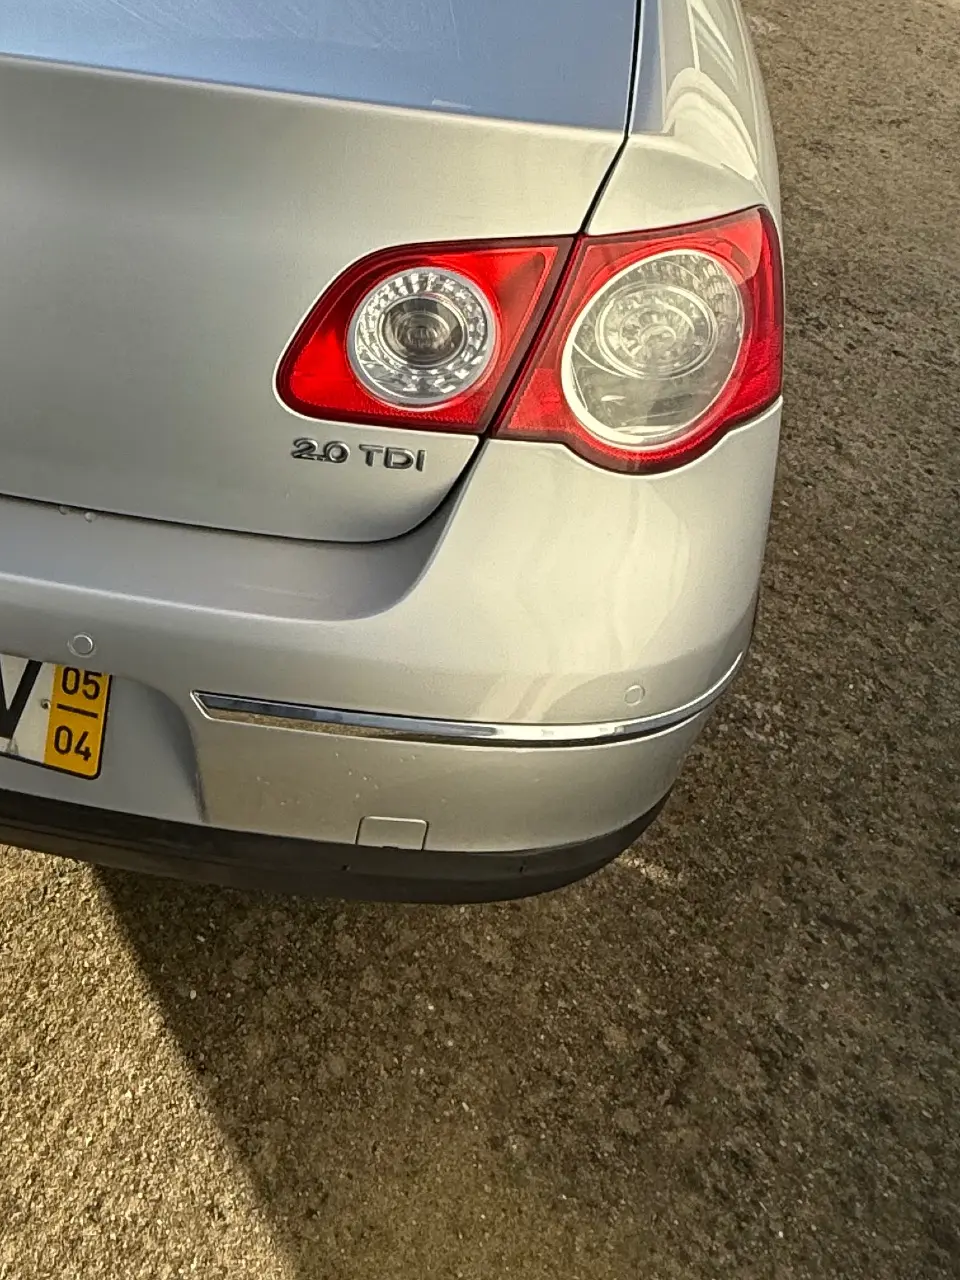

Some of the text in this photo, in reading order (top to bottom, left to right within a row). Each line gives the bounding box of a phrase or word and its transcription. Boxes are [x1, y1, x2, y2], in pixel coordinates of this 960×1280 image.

[291, 437, 426, 471] 2.0 TDI
[61, 666, 101, 701] 05
[53, 725, 92, 761] 04
